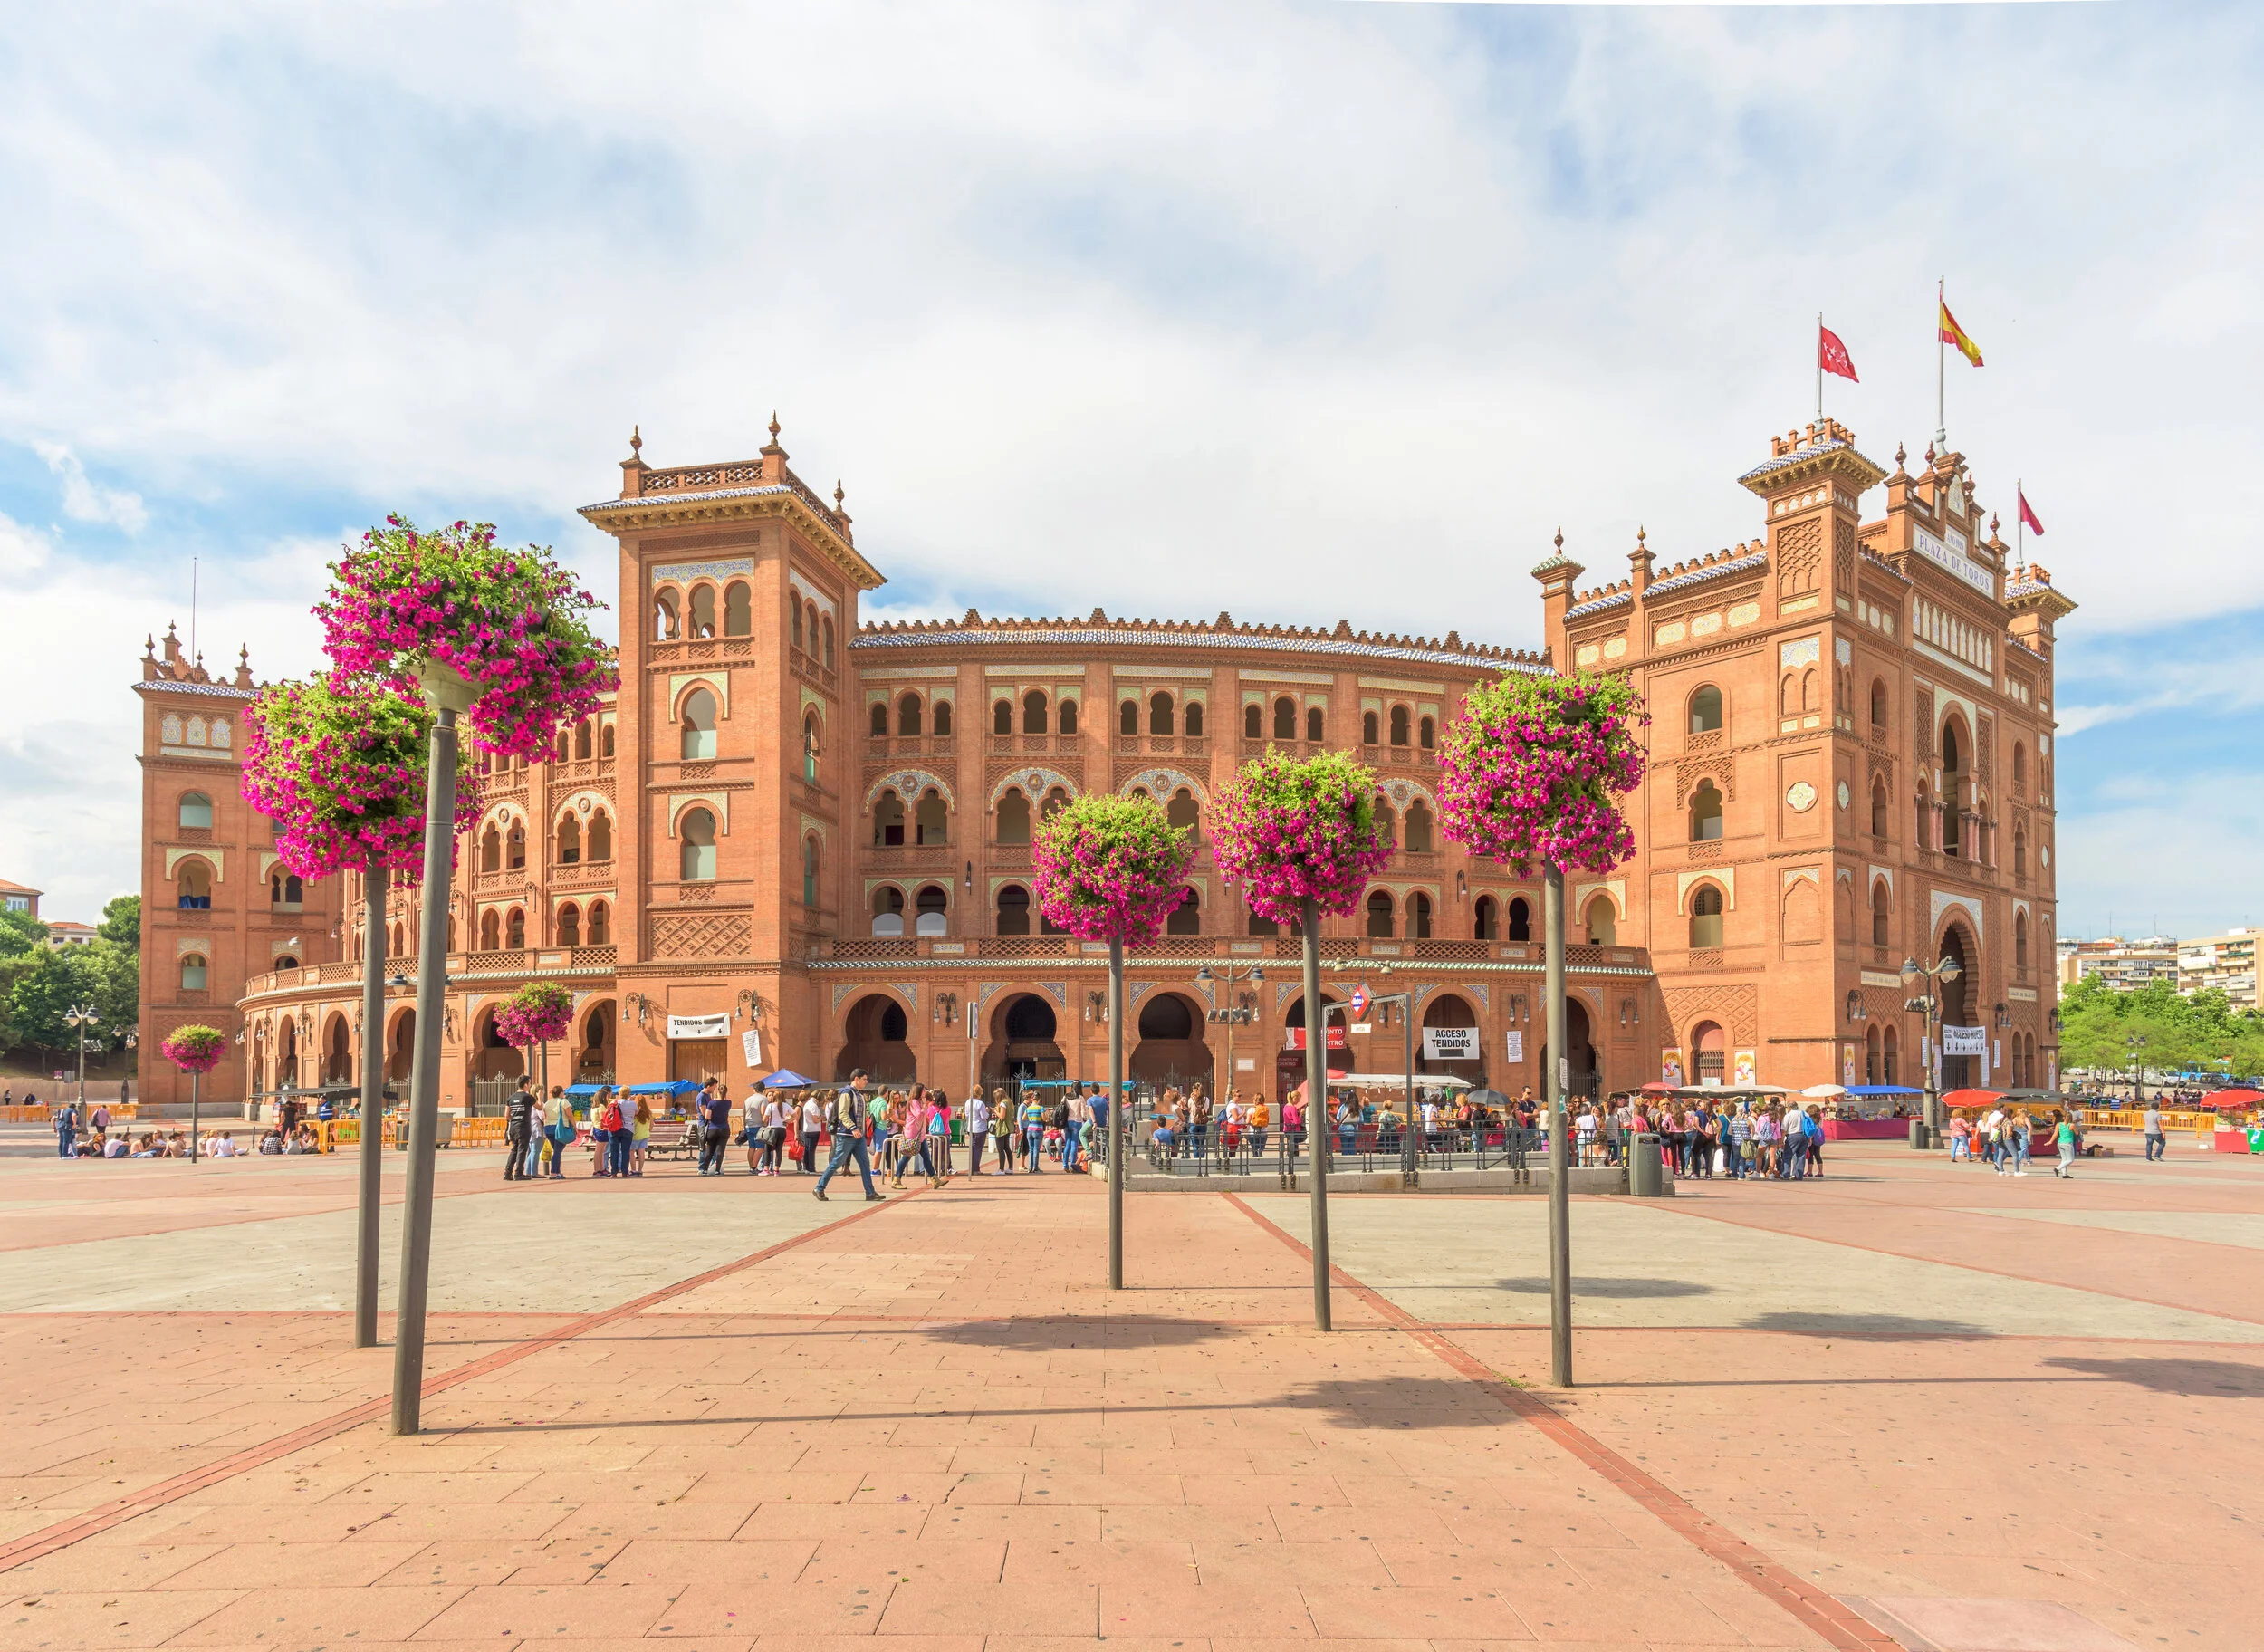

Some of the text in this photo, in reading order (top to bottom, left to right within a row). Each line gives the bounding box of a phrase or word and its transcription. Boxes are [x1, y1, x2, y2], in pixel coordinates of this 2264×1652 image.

[1919, 534, 1990, 591] PLAZA DE TOROS
[1435, 1030, 1467, 1038] ACCESO
[1432, 1039, 1471, 1048] TENDIDOS
